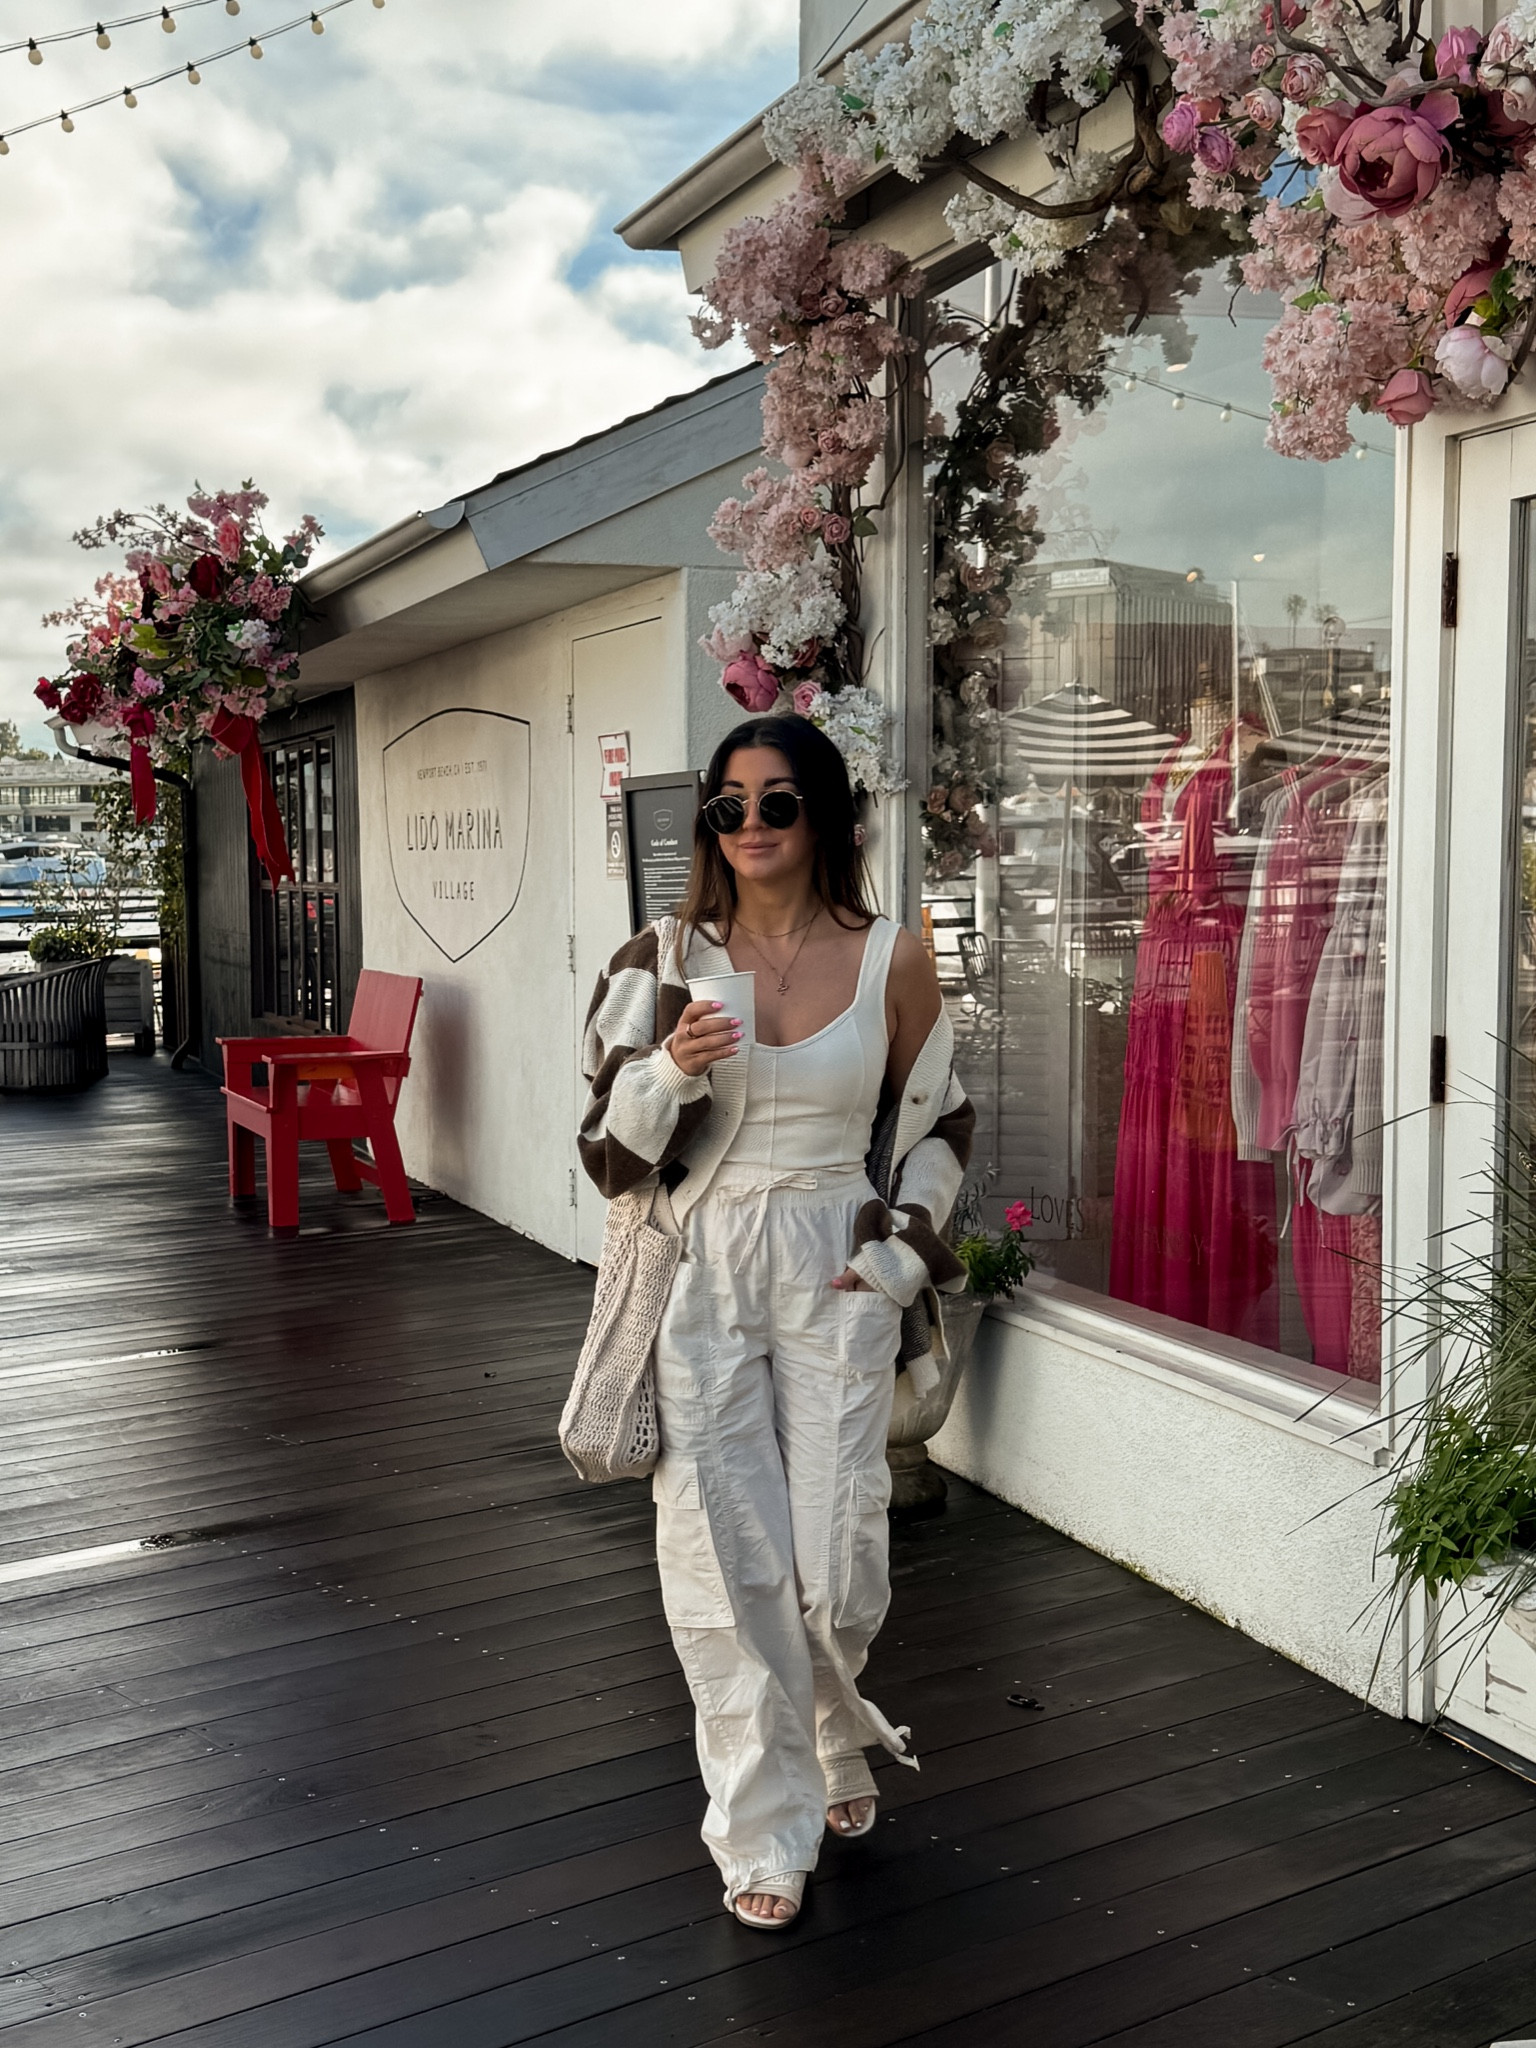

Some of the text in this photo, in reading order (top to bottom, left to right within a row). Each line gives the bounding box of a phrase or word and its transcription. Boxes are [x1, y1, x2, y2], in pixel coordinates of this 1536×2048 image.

[406, 806, 503, 851] LIDO MARINA
[432, 880, 475, 901] VILLAGE
